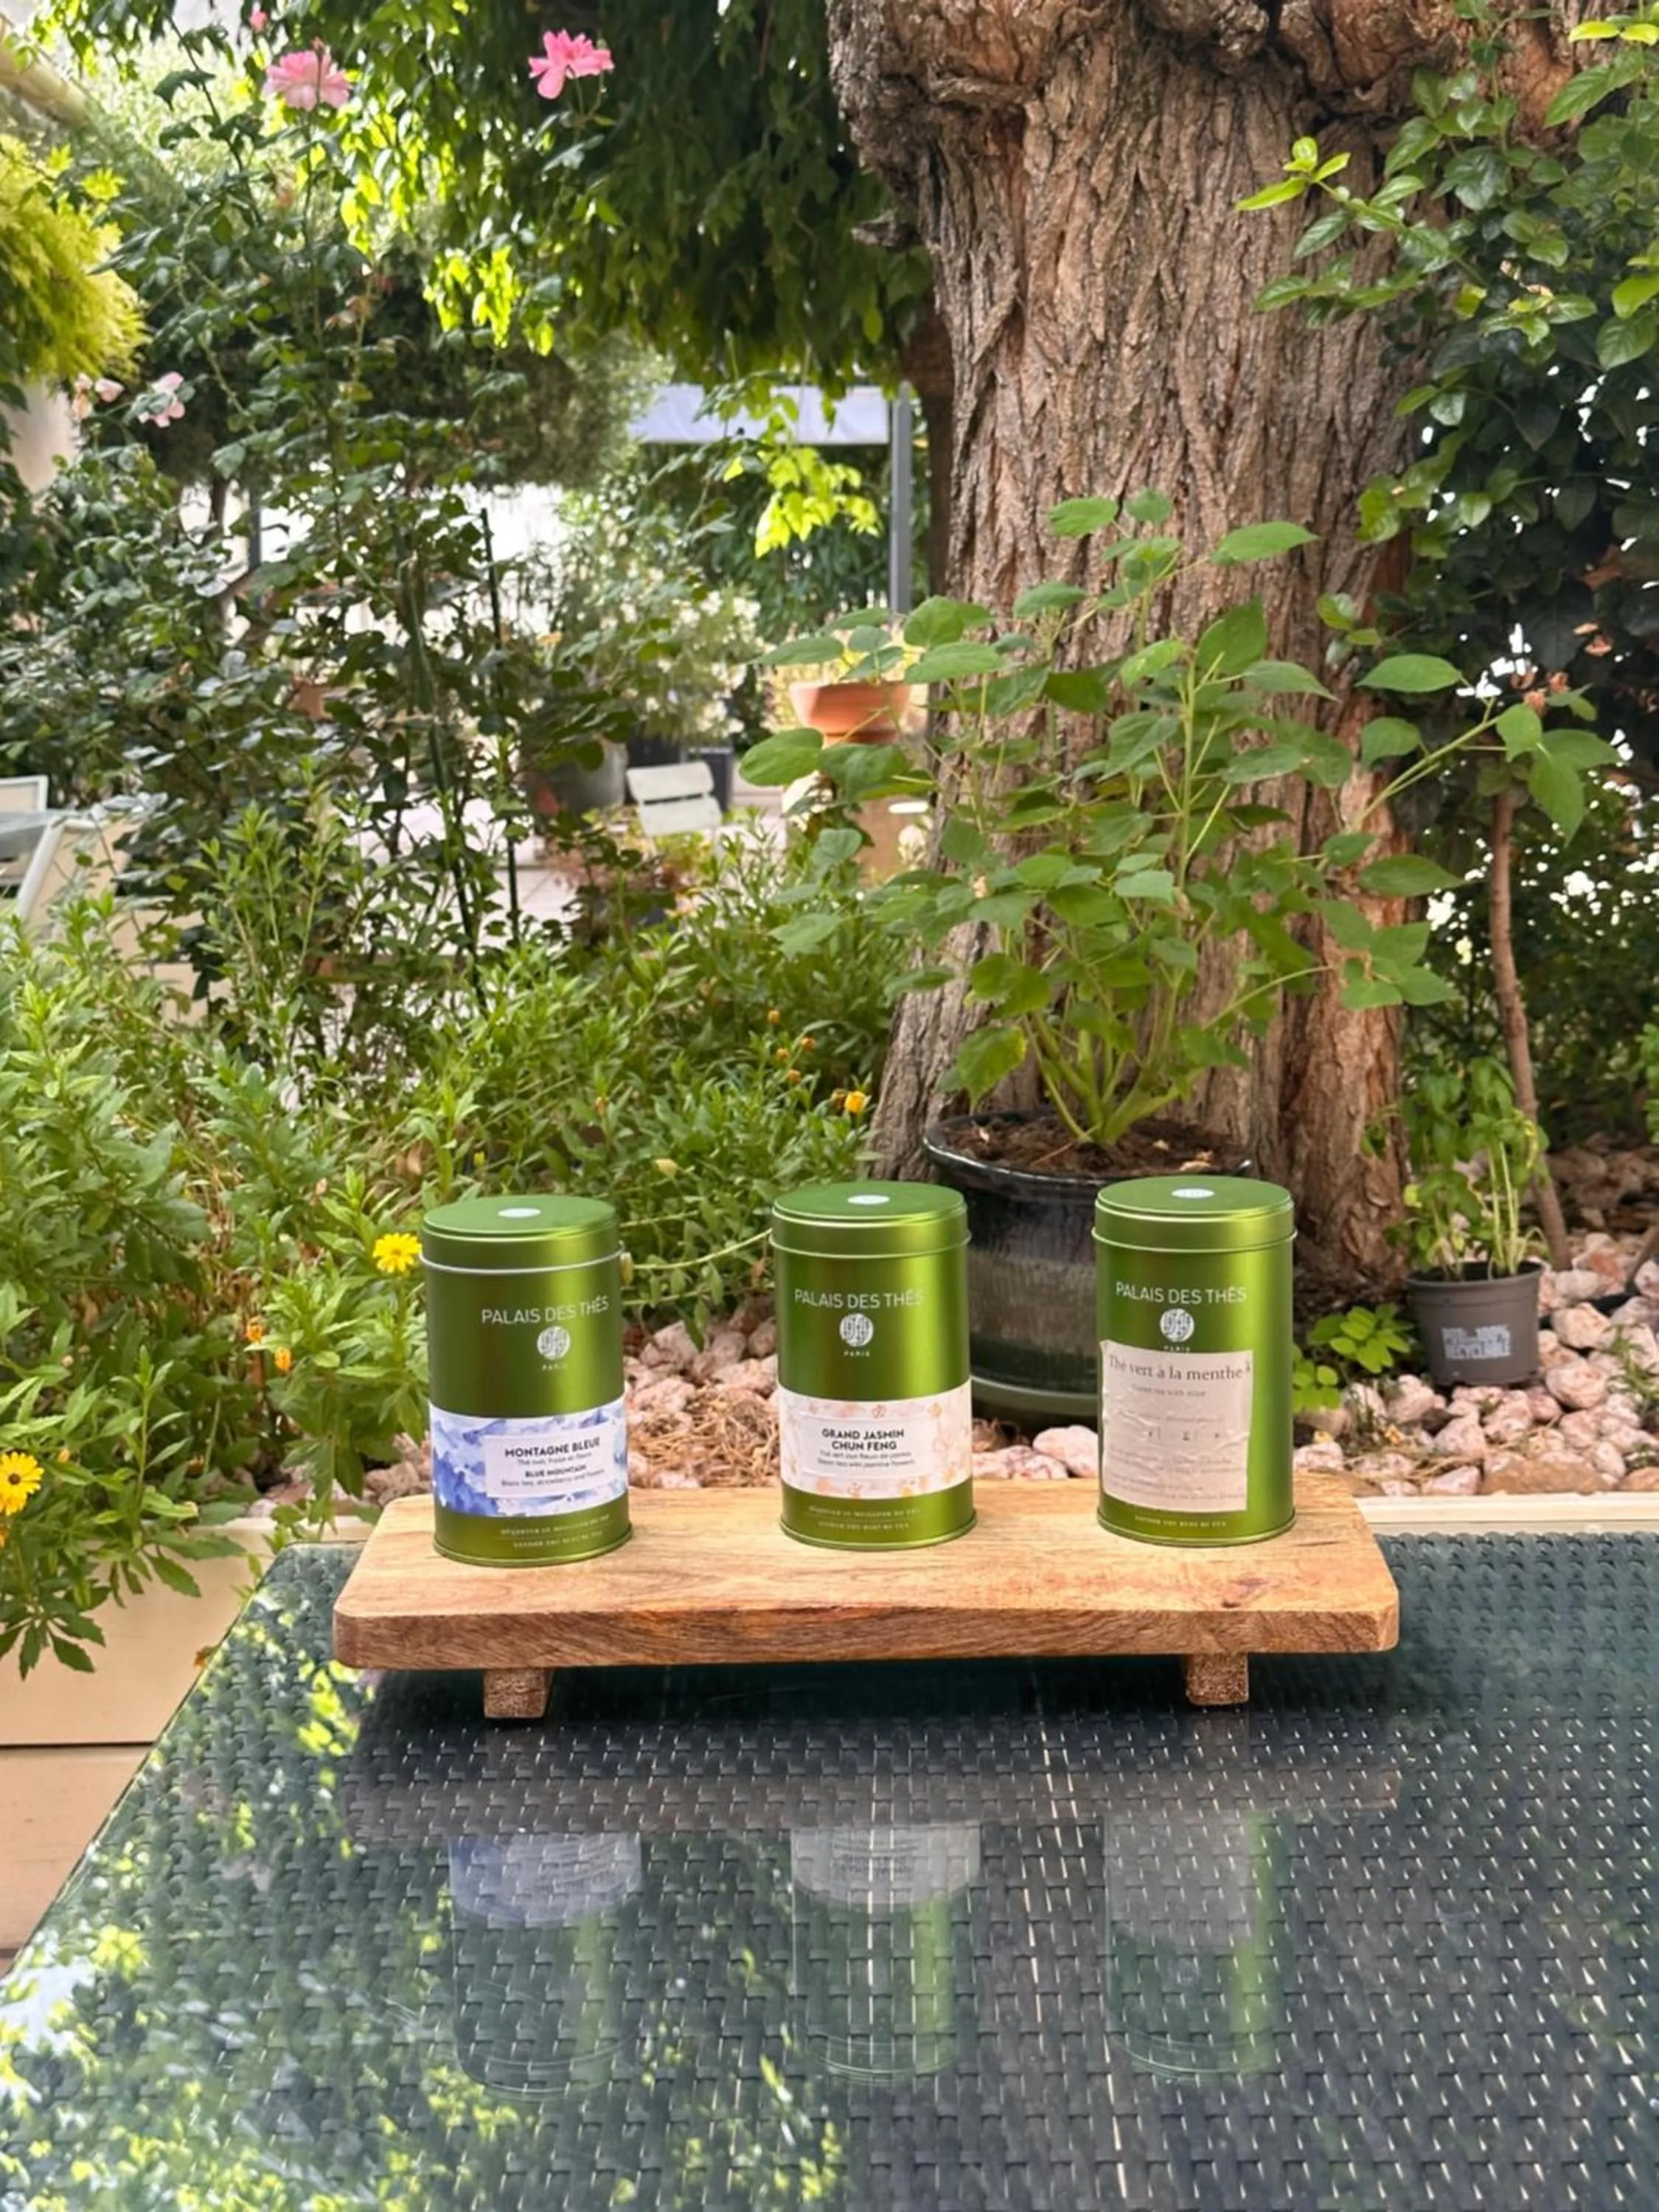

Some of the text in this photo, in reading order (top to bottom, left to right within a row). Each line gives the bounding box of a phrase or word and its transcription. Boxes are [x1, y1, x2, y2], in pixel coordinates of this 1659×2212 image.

[794, 1289, 844, 1309] PALAIS
[847, 1293, 880, 1309] DES
[1116, 1281, 1165, 1303] PALAIS
[1169, 1288, 1202, 1304] DES
[481, 1308, 541, 1325] PALAIS
[545, 1304, 577, 1322] DES
[1129, 1364, 1152, 1377] vert
[1156, 1367, 1166, 1379] à
[1169, 1366, 1182, 1380] la
[821, 1427, 905, 1440] GRAND JASMIN
[504, 1436, 599, 1458] MONTAGNE BLEUE
[832, 1440, 897, 1452] CHUN FENG
